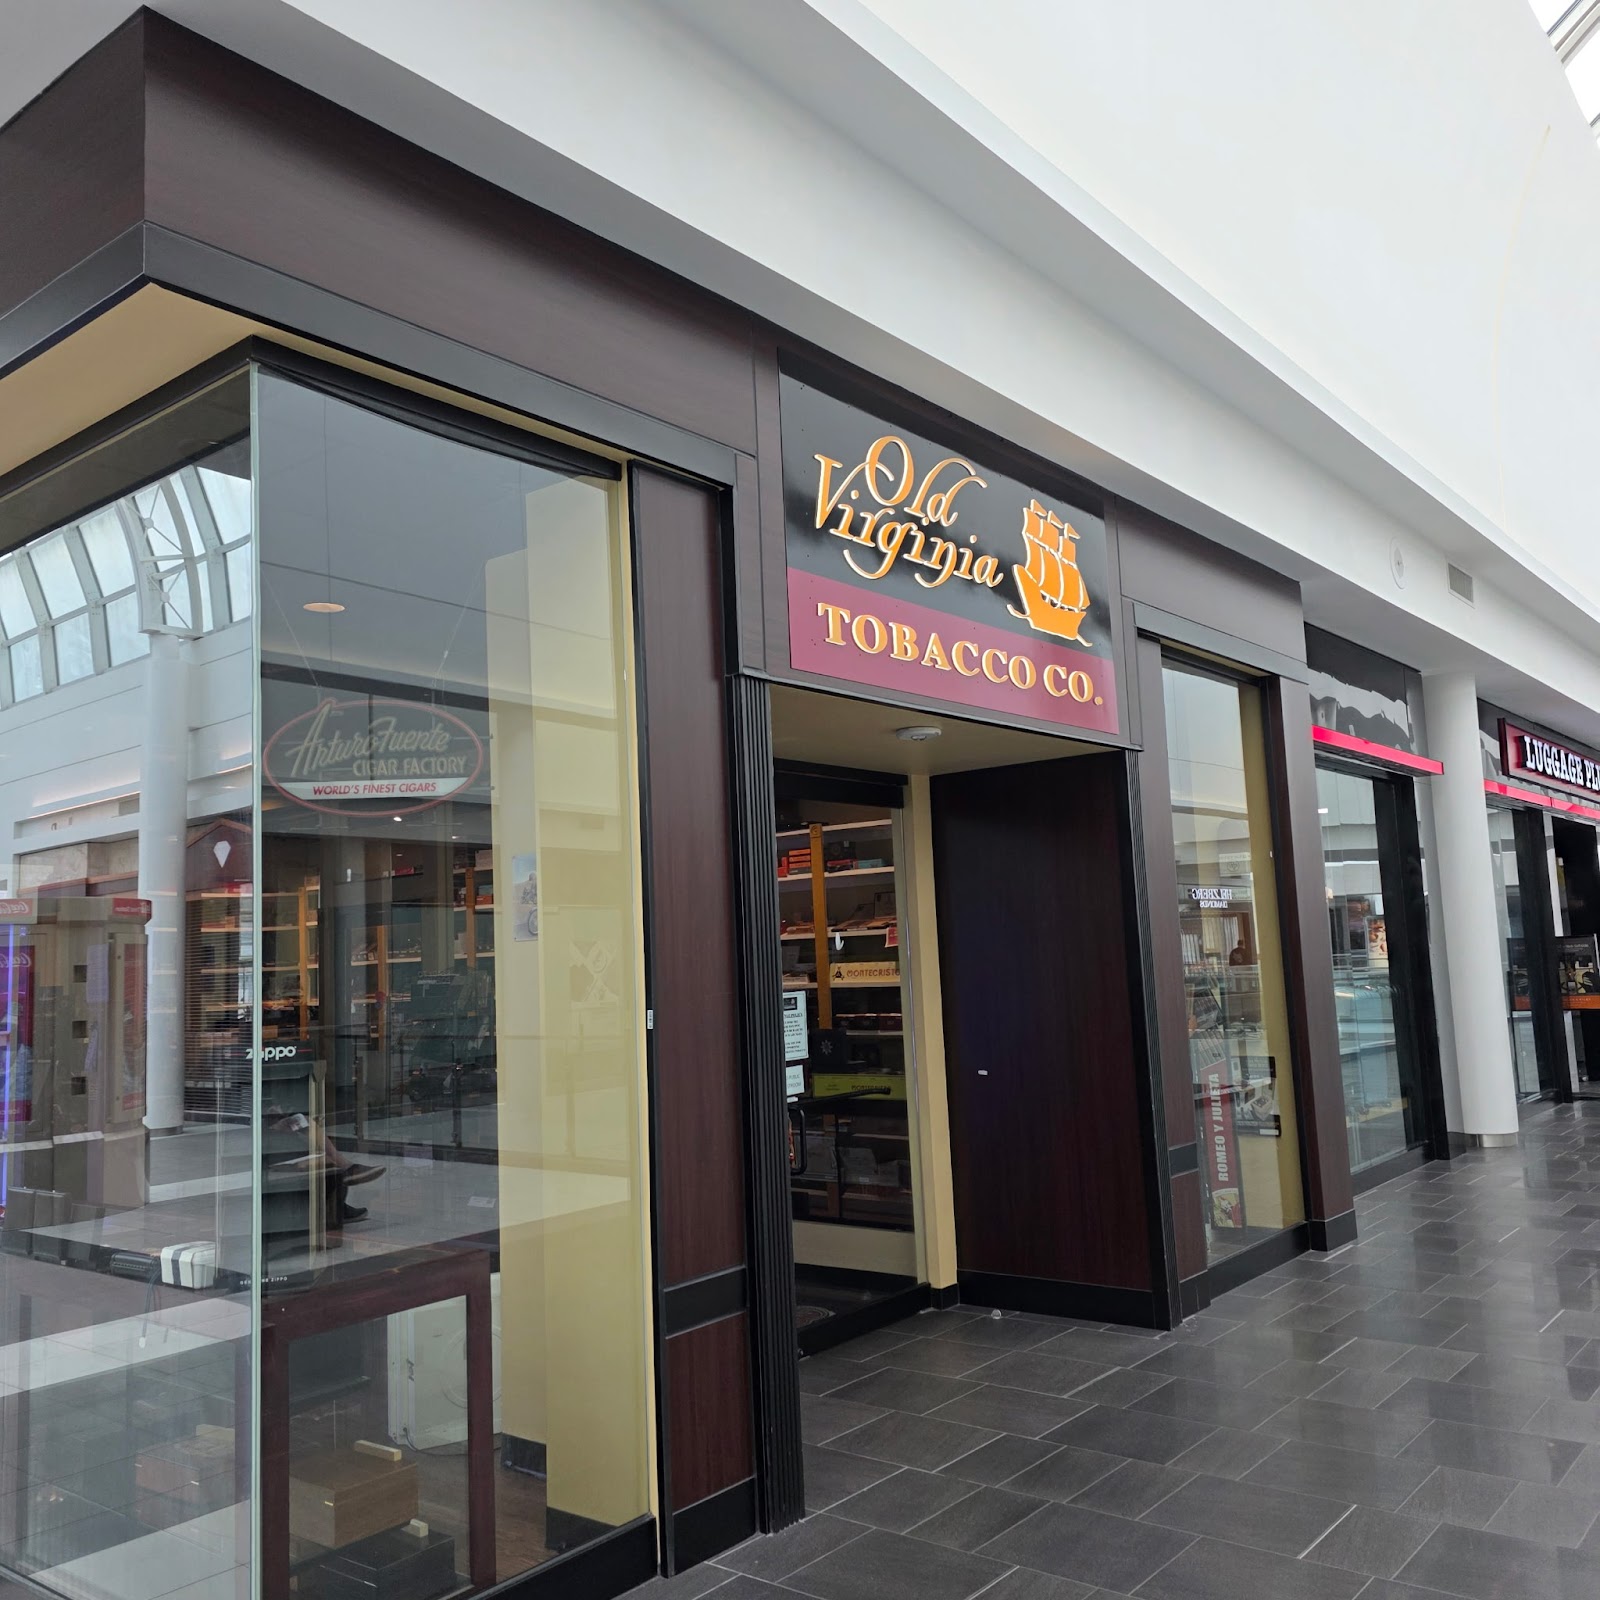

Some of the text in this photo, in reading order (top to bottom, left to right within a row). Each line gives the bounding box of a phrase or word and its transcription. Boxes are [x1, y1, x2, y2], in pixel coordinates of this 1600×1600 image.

[813, 453, 1004, 588] Virginia
[864, 435, 987, 527] Old
[817, 602, 1104, 706] TOBACCO CO.
[285, 702, 451, 778] Arturo Fuente
[352, 756, 467, 777] CIGAR FACTORY
[1523, 735, 1600, 791] LUGGAGE PL
[312, 783, 437, 796] WORLD'S FINEST CIGARS
[1208, 1073, 1229, 1182] ROMEO Y JULIETA
